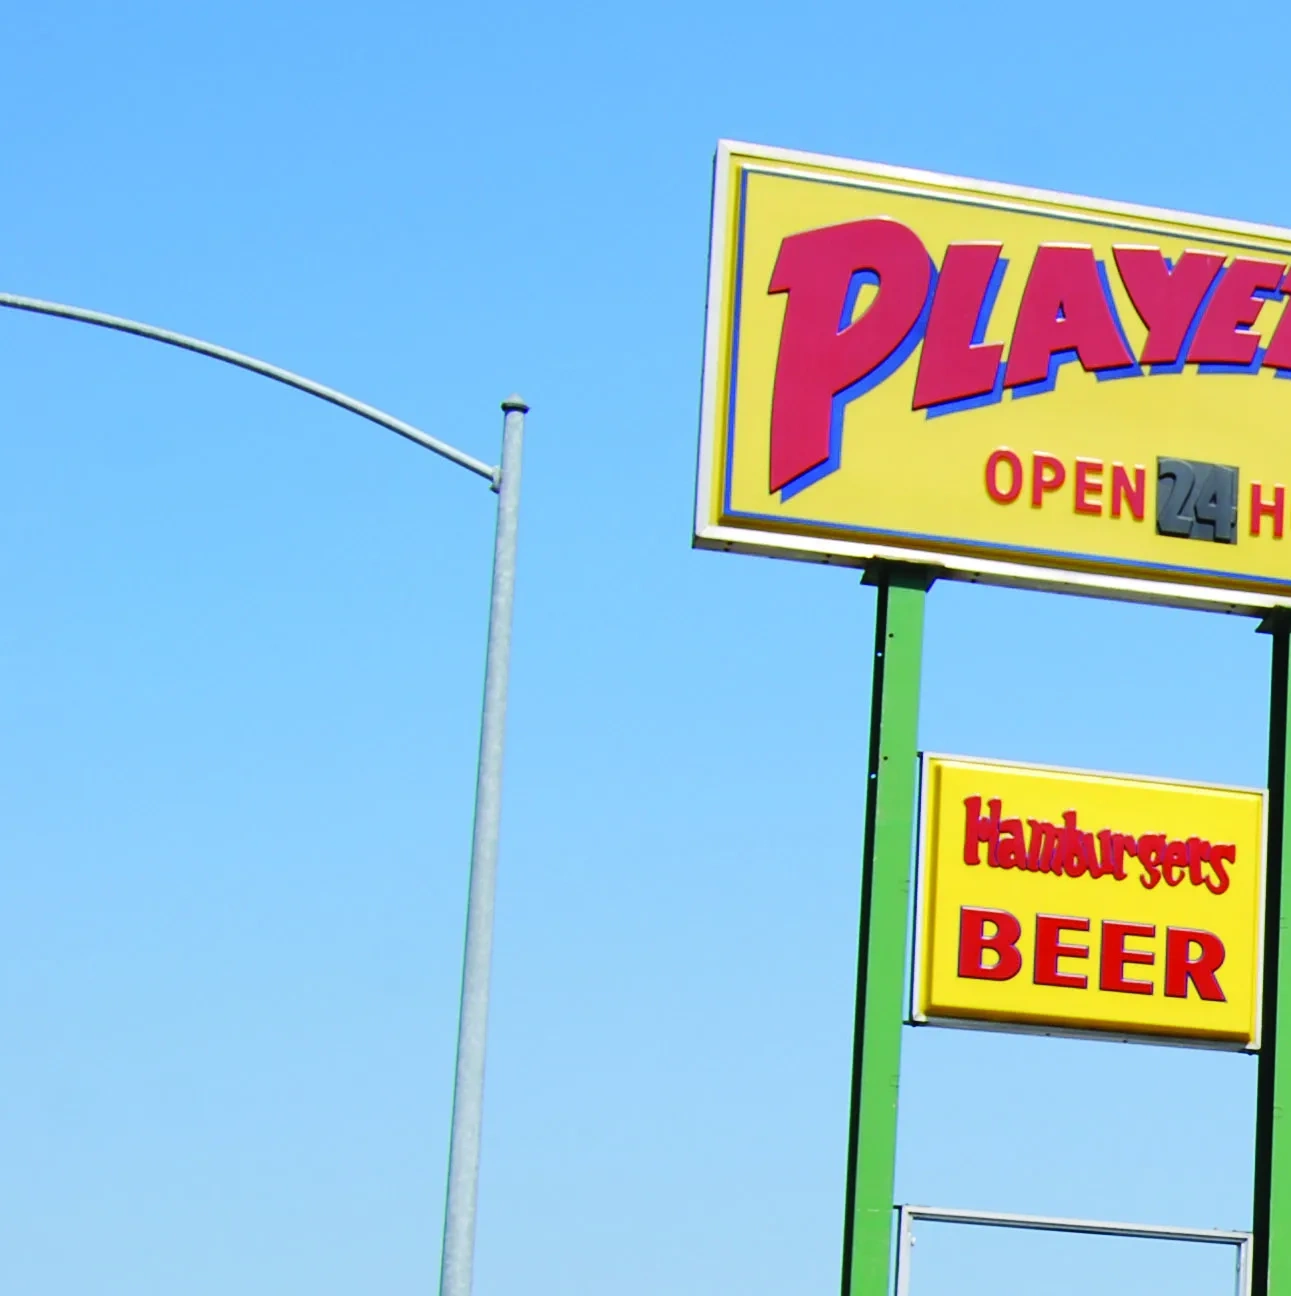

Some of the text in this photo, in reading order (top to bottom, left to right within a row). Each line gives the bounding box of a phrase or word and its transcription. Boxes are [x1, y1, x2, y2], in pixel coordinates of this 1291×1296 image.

[984, 446, 1146, 522] OPEN
[1156, 457, 1238, 544] 24
[963, 794, 1236, 895] Hamburgers
[957, 905, 1228, 1002] BEER
